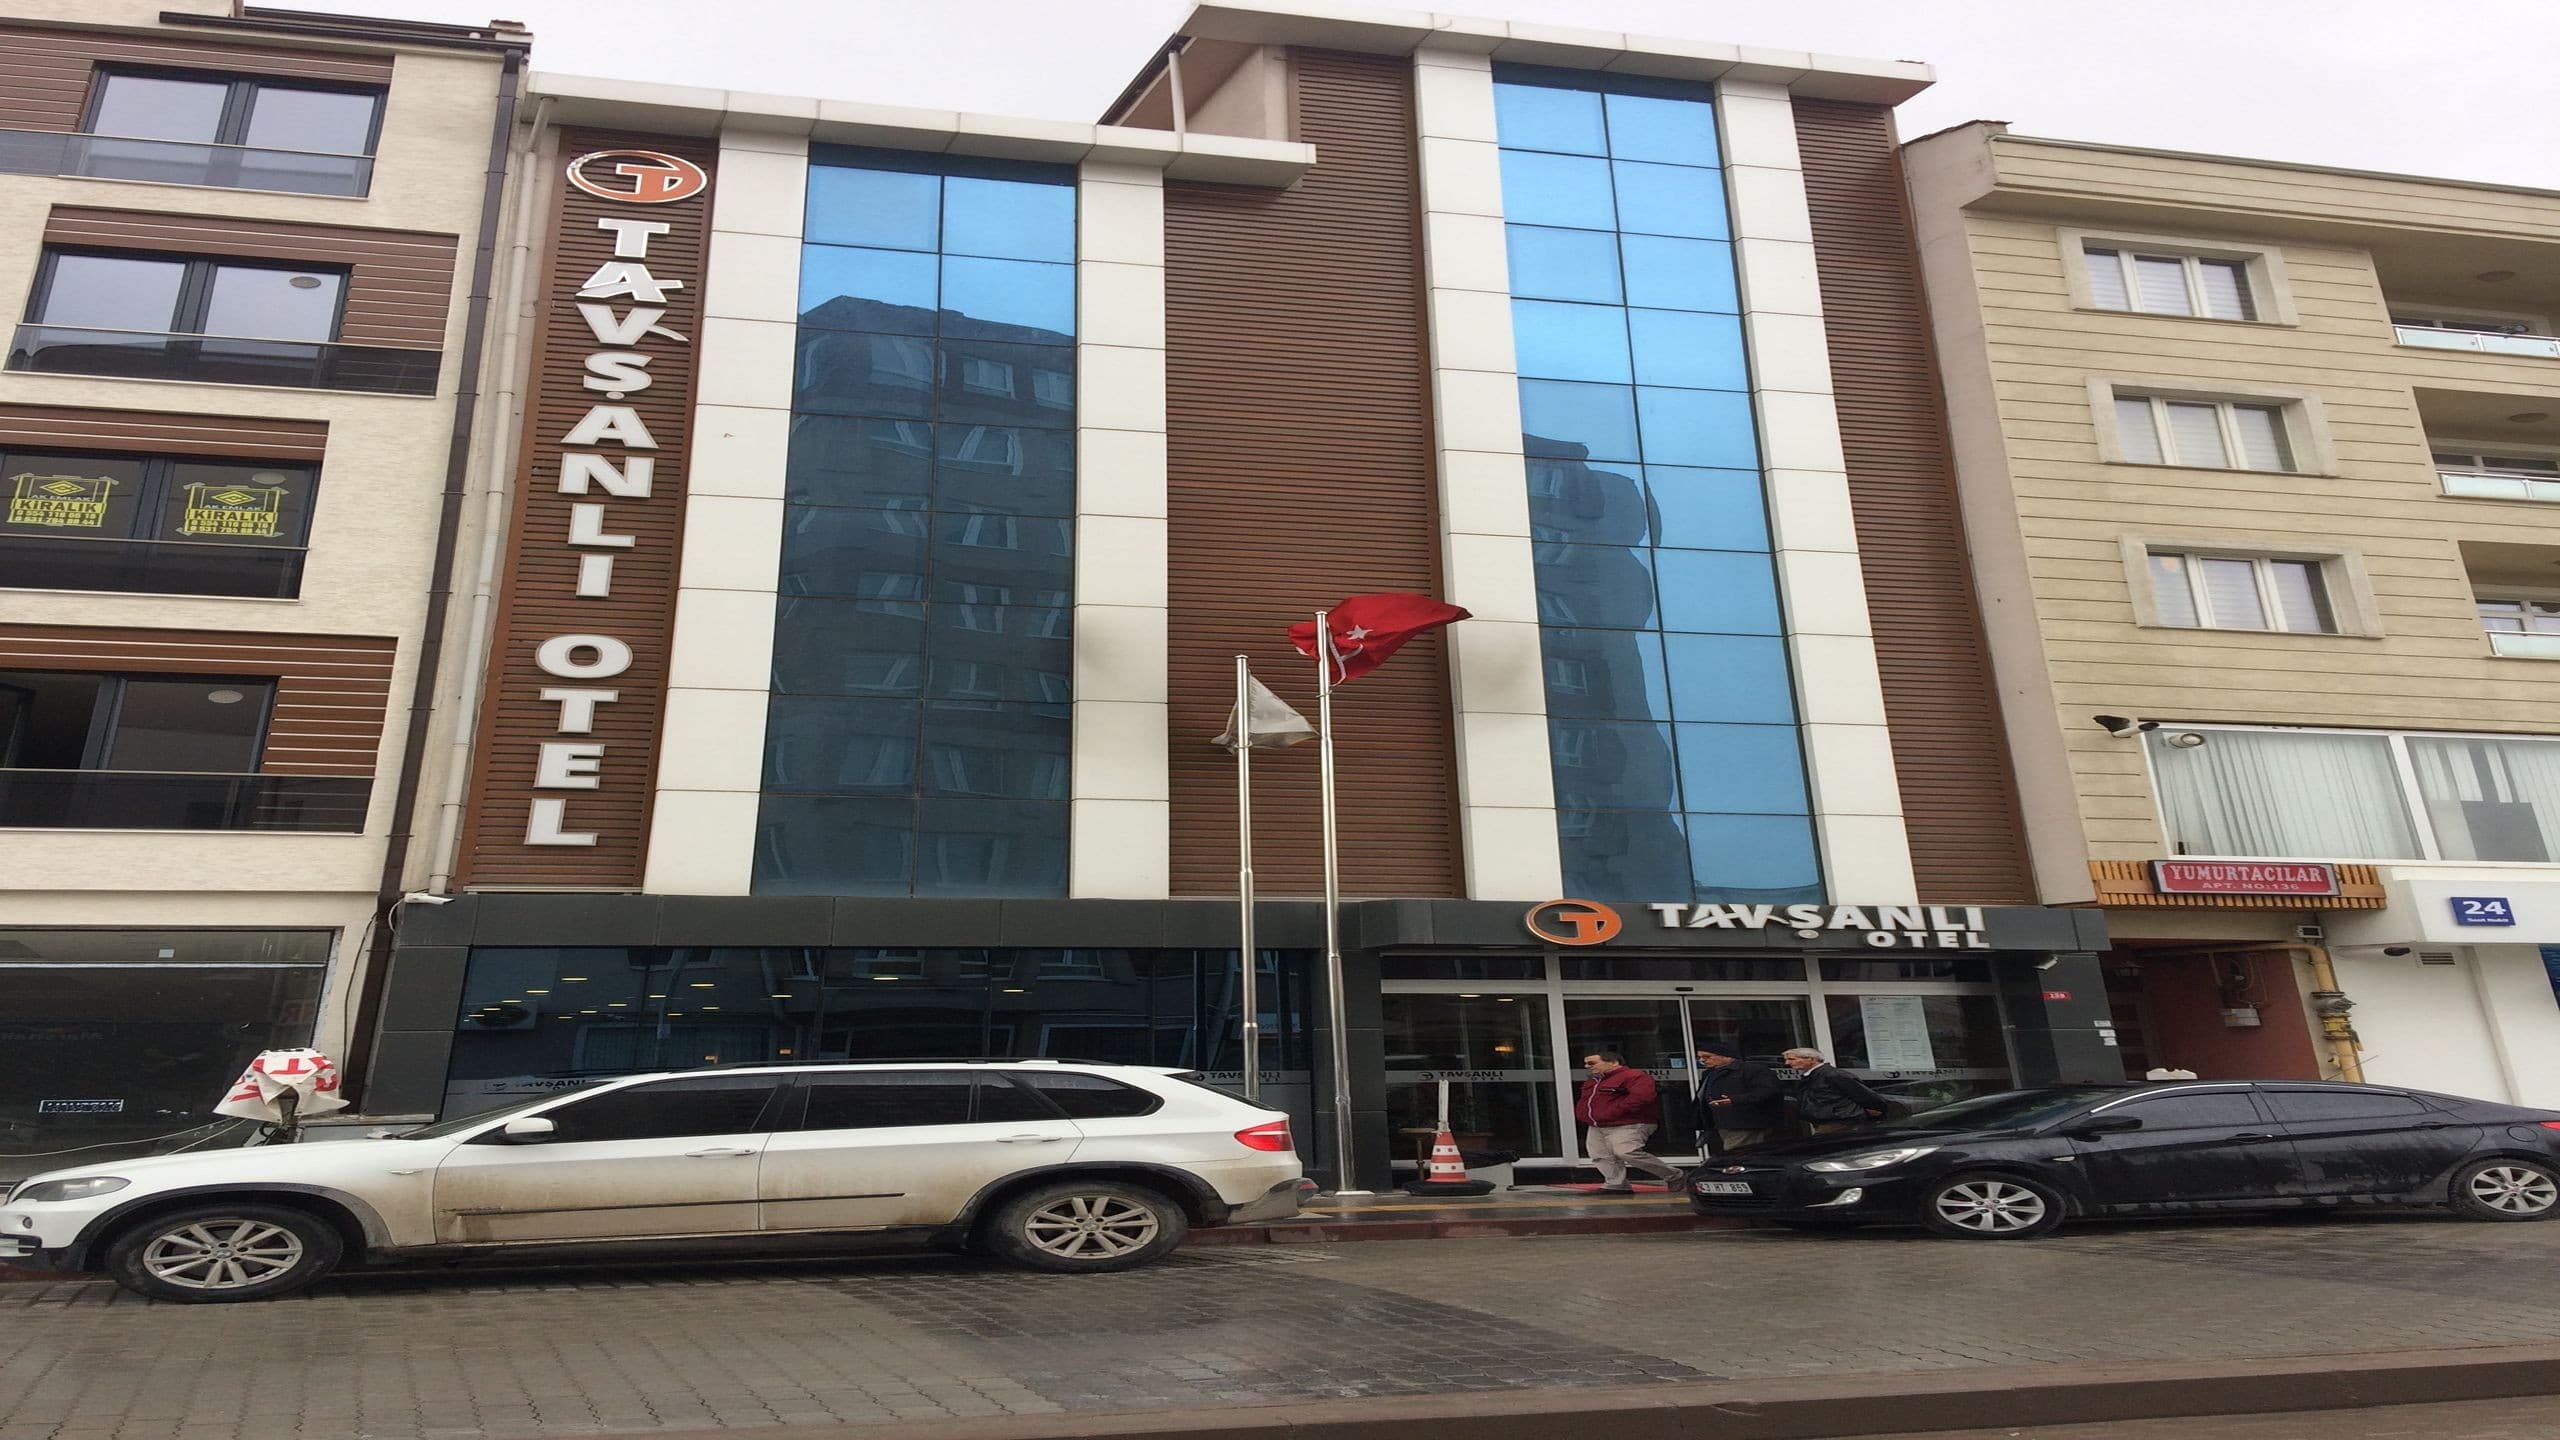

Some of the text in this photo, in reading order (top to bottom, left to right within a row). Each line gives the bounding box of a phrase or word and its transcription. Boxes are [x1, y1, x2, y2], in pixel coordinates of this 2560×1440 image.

[523, 217, 690, 846] TAVŞANLI OTEL
[2169, 864, 2323, 882] YUMURTACILAR
[2462, 900, 2507, 915] 24
[1648, 902, 1986, 940] TAVŞANLI
[1866, 931, 1990, 949] OTEL
